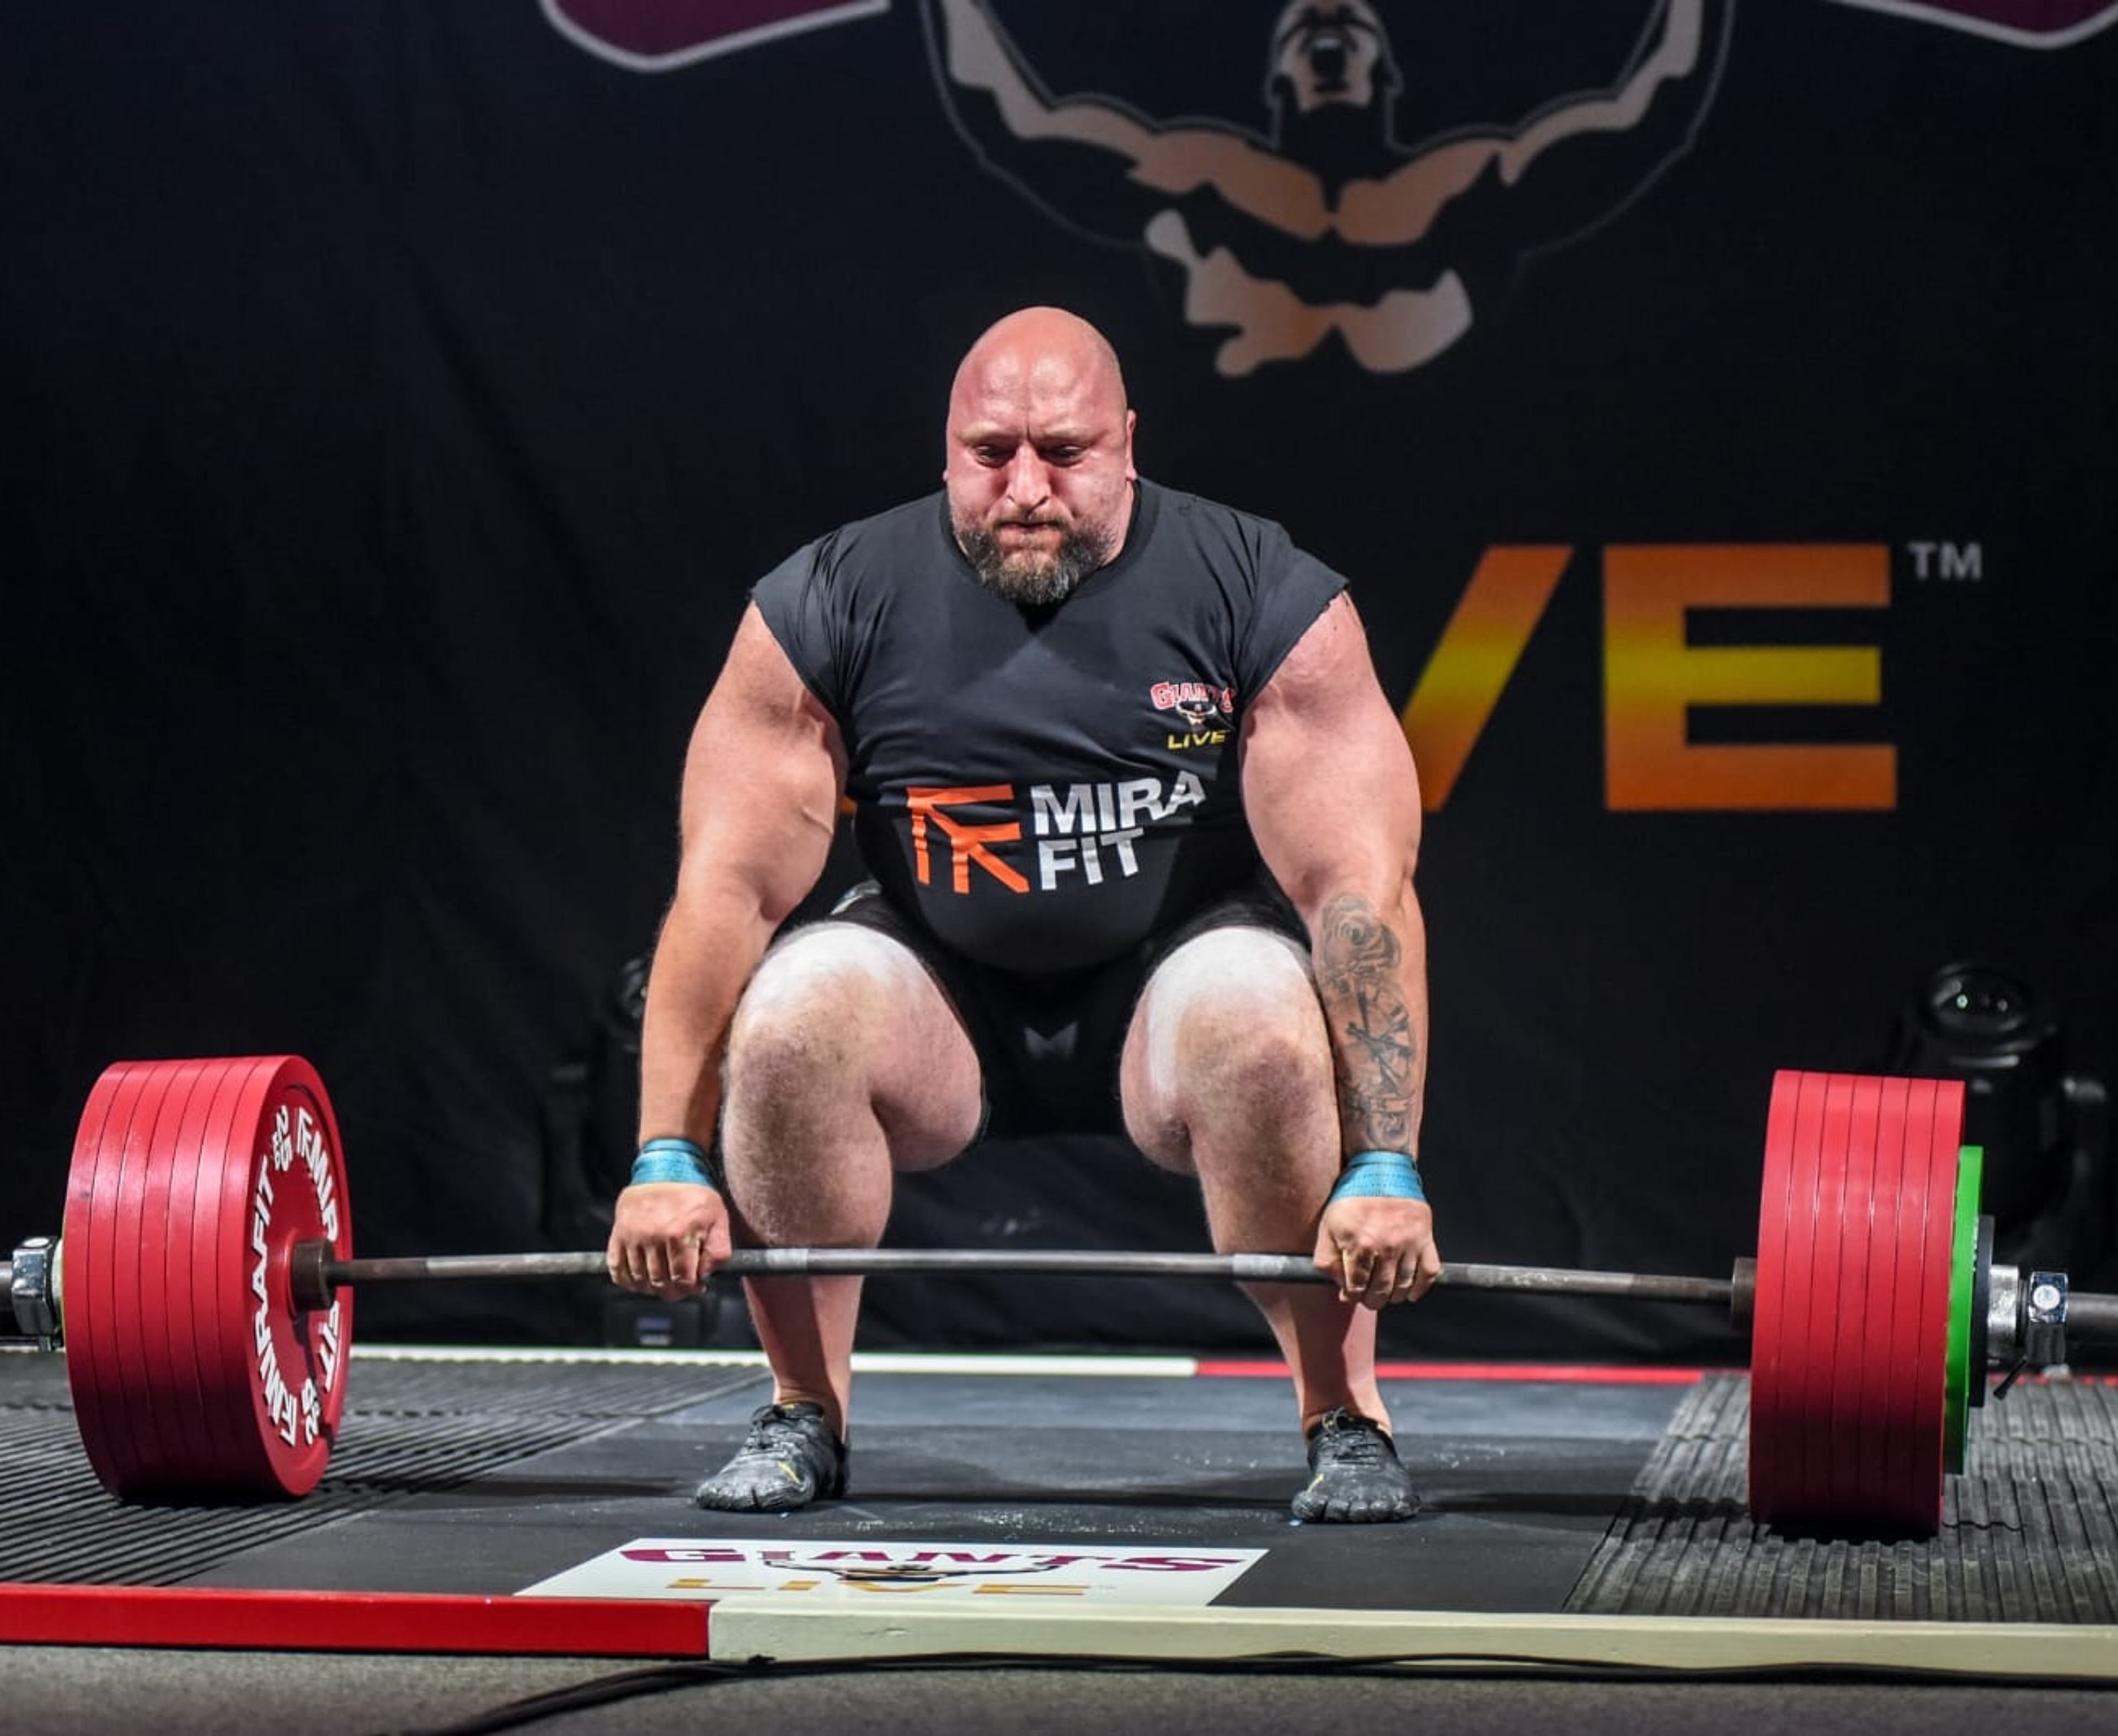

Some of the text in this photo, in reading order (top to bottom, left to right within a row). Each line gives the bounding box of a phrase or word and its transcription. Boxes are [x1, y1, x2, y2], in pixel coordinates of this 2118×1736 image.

[1168, 729, 1227, 750] LIVE
[1030, 770, 1207, 835] MIRA
[1038, 827, 1145, 891] FIT
[252, 1153, 284, 1425] MIRAFIT
[620, 1548, 1245, 1571] GIANTS
[666, 1578, 1090, 1595] LIVE
